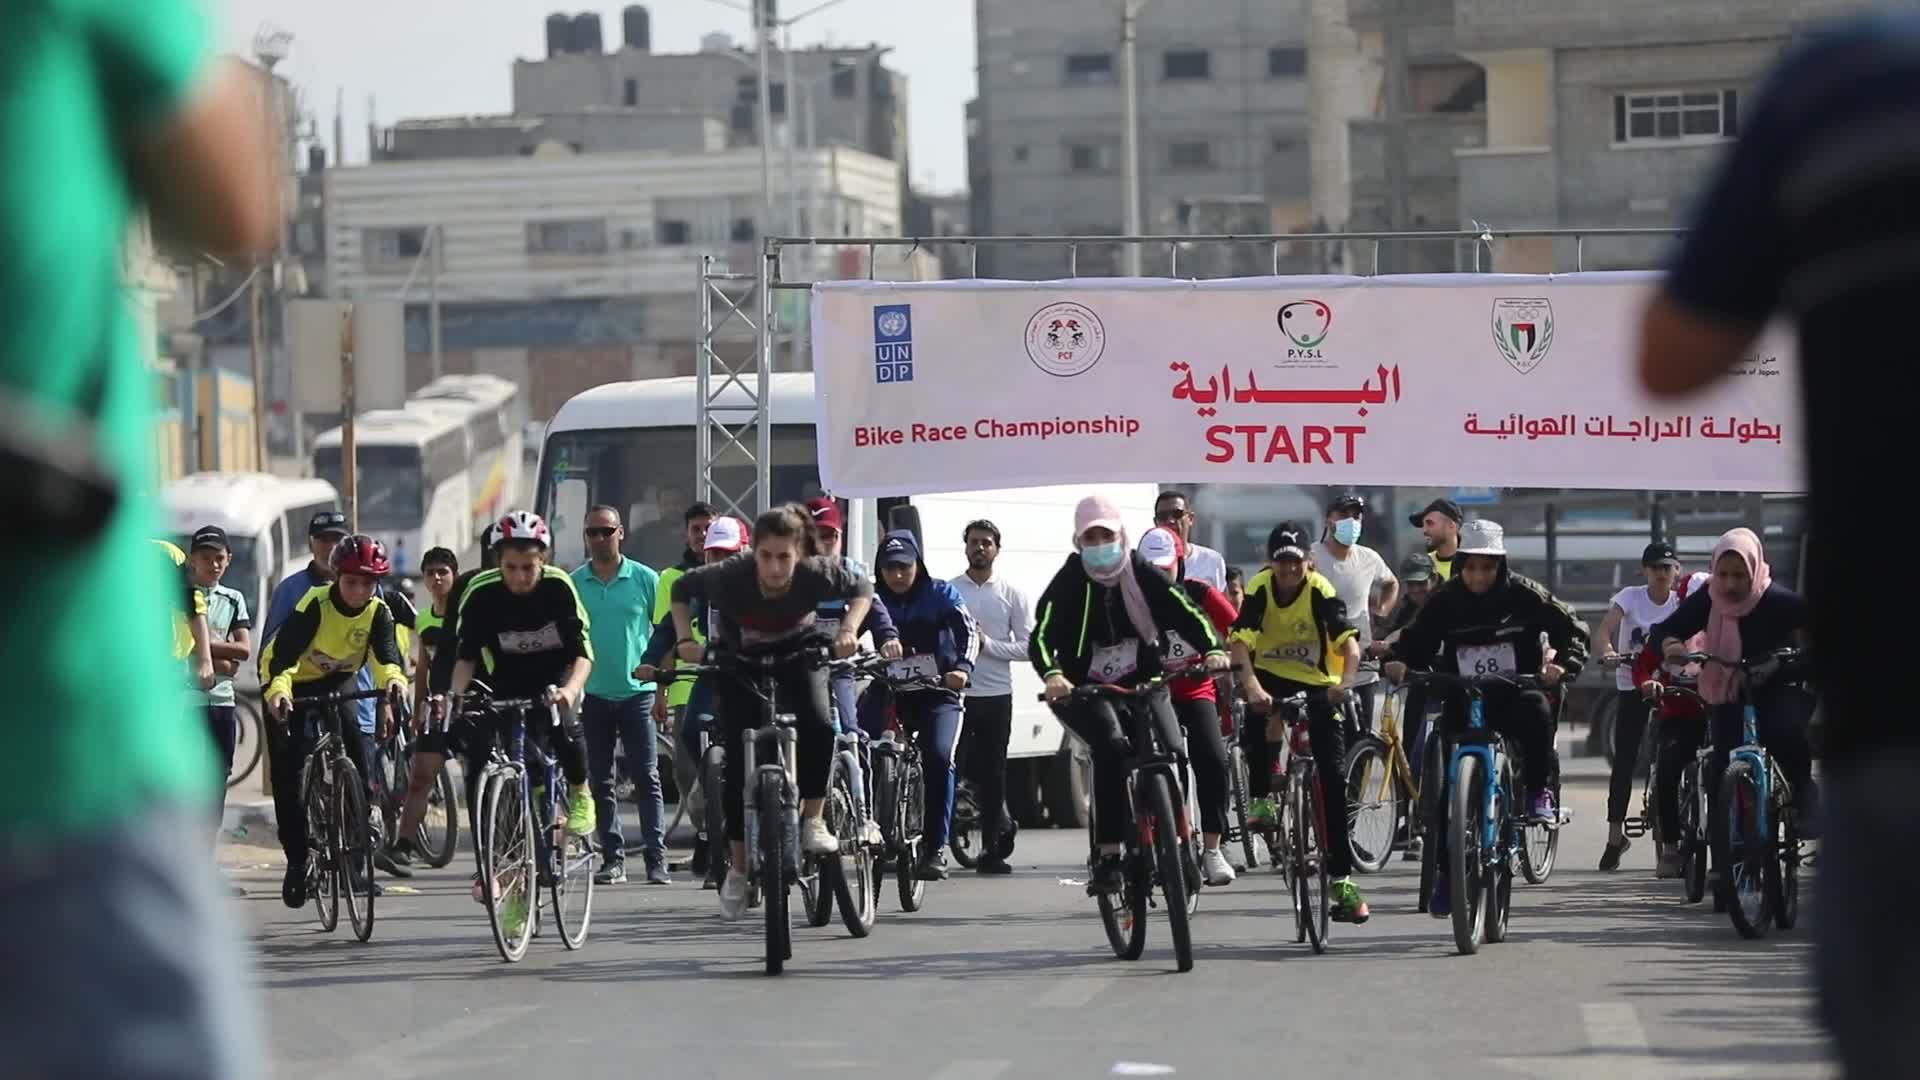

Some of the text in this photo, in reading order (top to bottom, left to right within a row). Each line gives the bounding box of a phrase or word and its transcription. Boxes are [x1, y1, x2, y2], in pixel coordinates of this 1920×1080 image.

[854, 415, 1140, 447] Bike Race Championship
[1204, 424, 1367, 464] START
[1463, 413, 1782, 444] بطولة الدراجات الهوائية
[1474, 657, 1499, 674] 68
